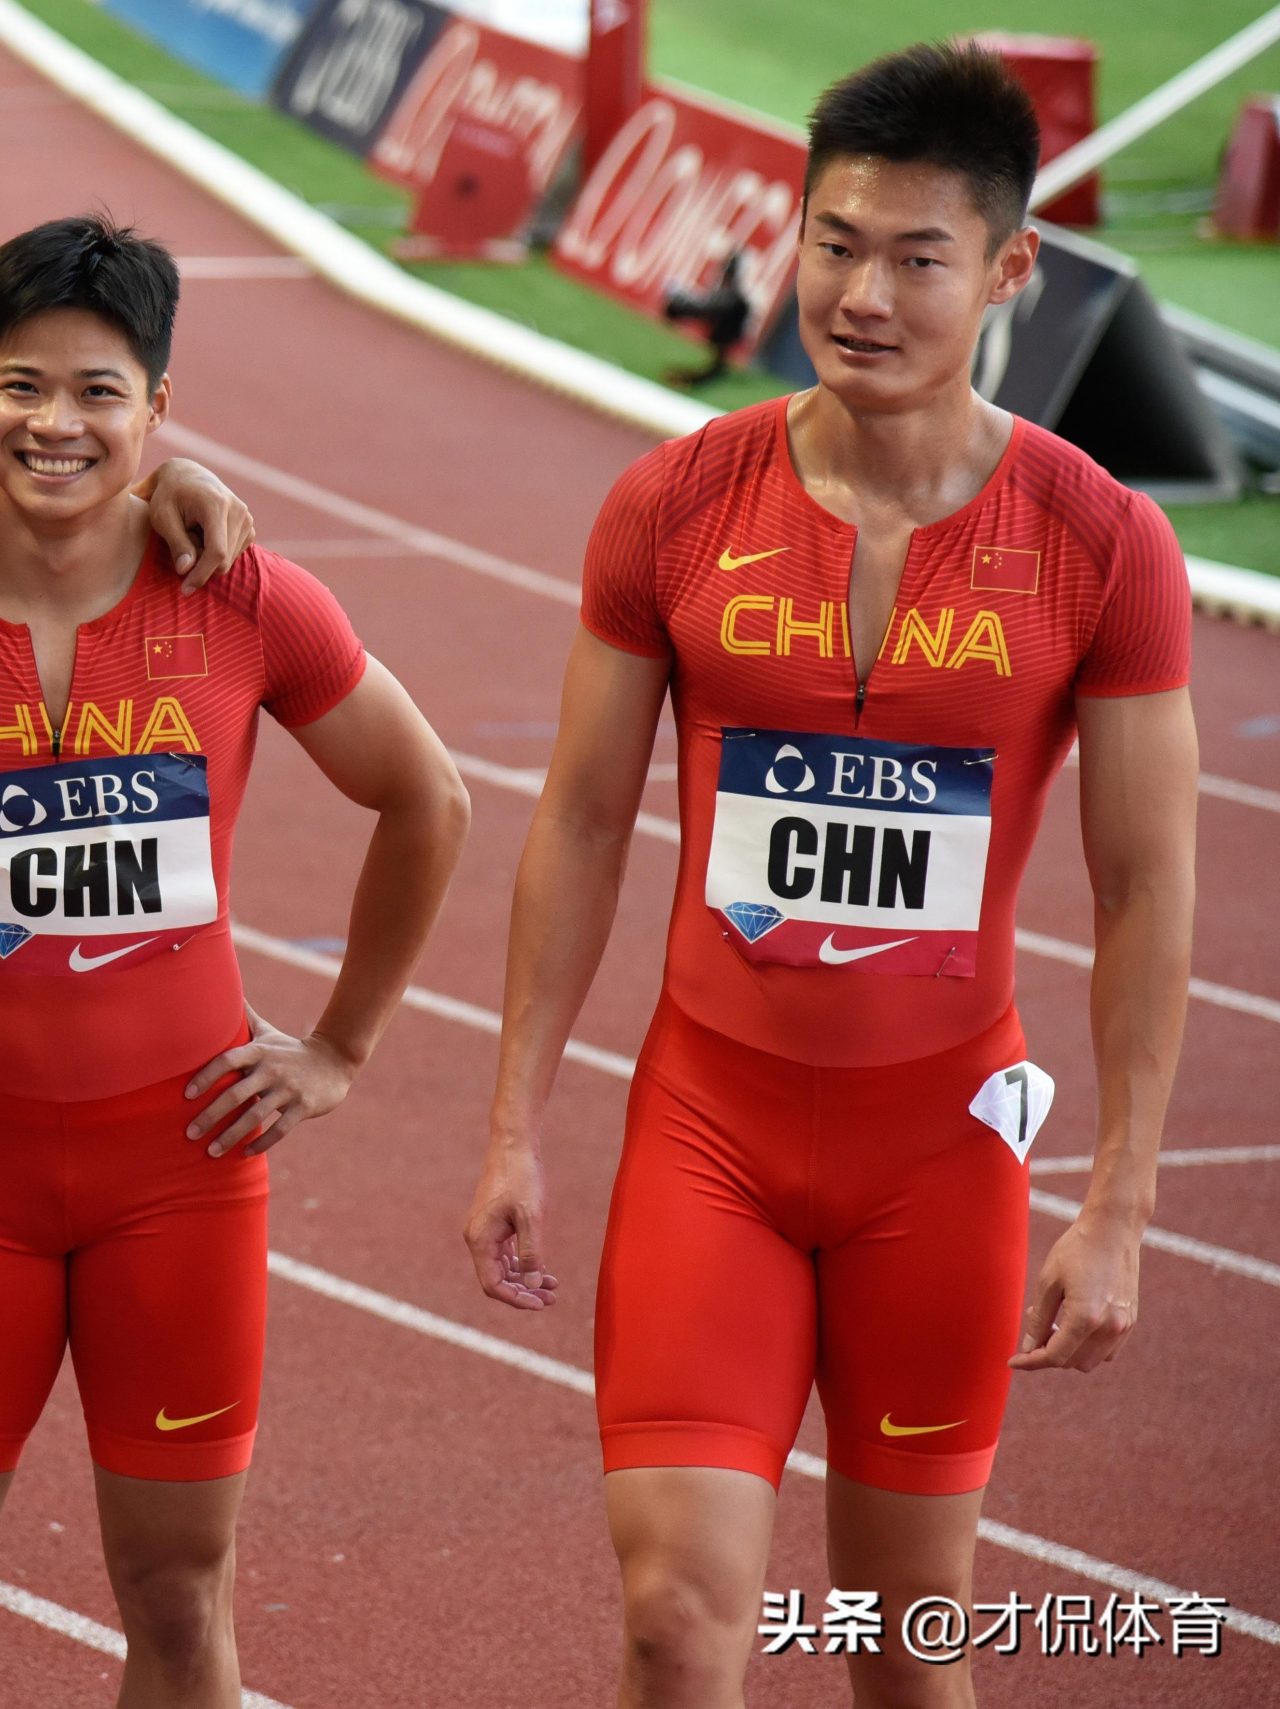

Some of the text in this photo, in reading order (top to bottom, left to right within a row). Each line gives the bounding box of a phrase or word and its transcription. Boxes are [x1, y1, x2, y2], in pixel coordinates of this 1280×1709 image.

[721, 595, 1012, 677] CHINA
[54, 770, 159, 822] EBS
[827, 752, 938, 805] EBS
[10, 837, 163, 917] CHN
[767, 816, 932, 910] CHN
